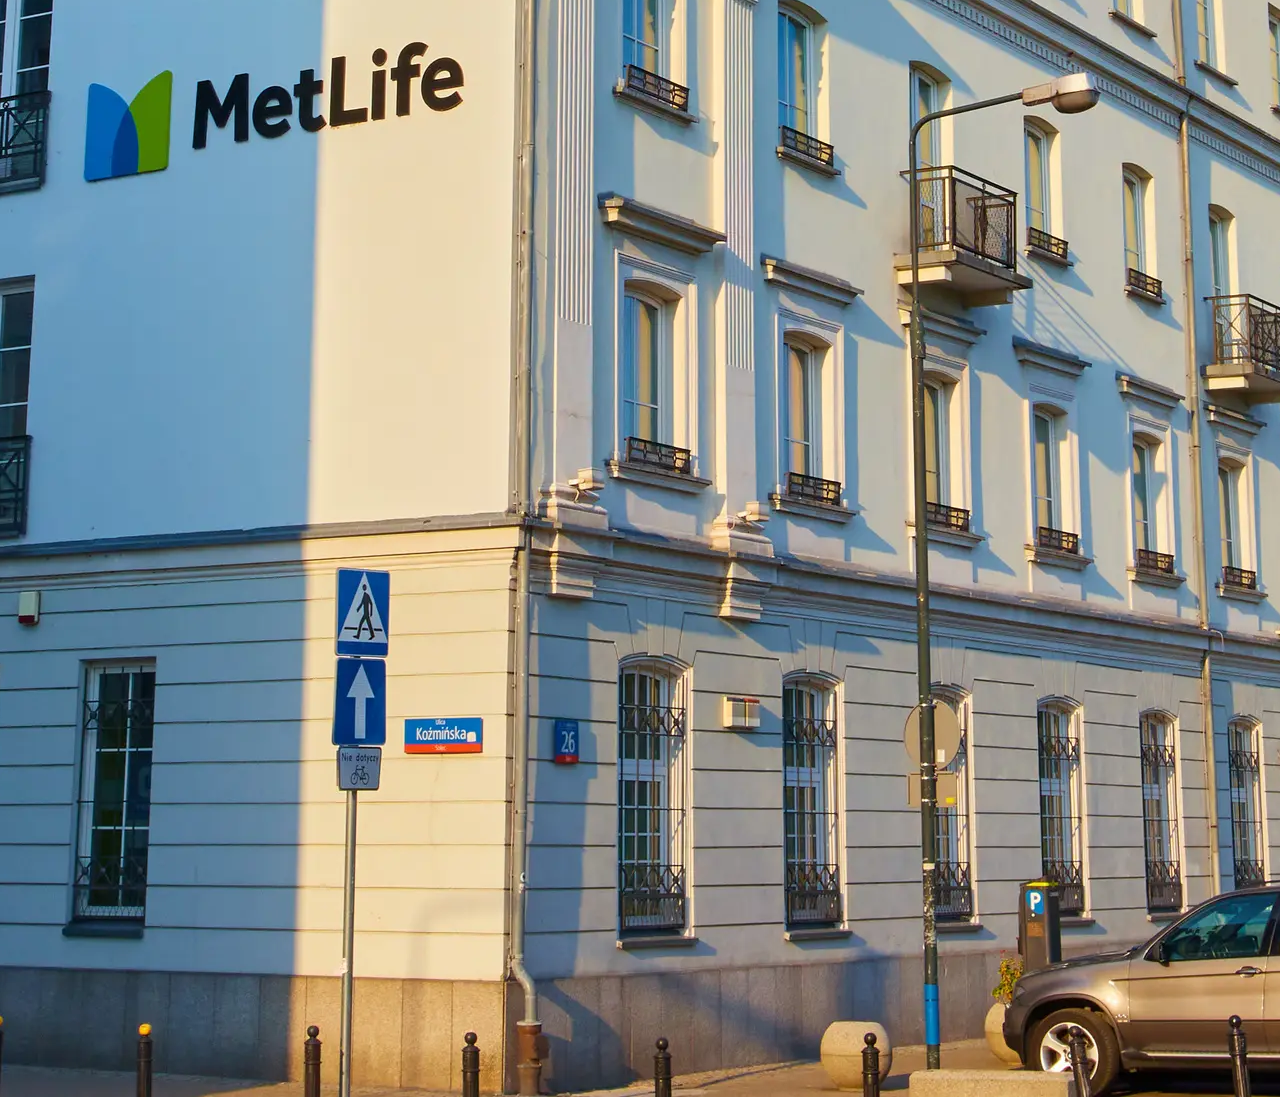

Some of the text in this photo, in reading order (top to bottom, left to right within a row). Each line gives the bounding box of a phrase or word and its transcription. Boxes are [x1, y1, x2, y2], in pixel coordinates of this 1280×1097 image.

[192, 41, 464, 150] MetLife
[416, 726, 467, 741] Koźmińska
[561, 731, 575, 753] 26
[341, 752, 379, 766] Nie dotyczy
[1030, 892, 1041, 911] P
